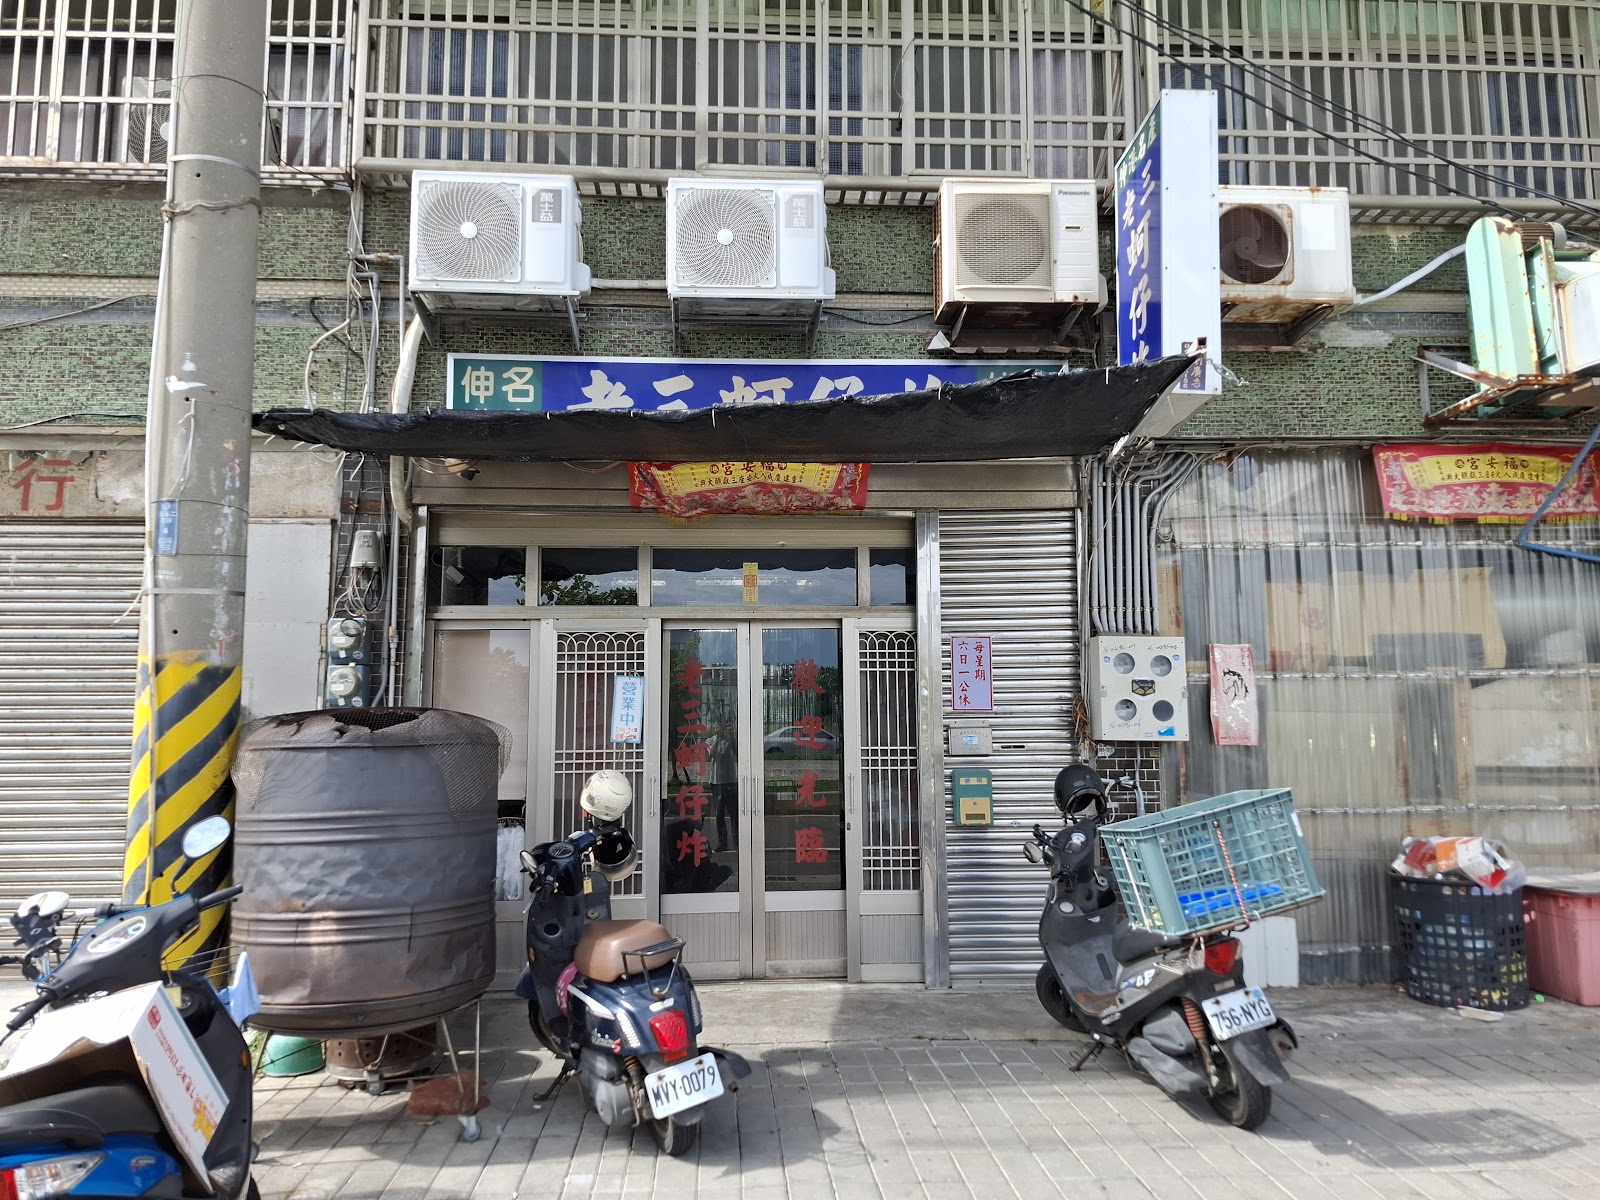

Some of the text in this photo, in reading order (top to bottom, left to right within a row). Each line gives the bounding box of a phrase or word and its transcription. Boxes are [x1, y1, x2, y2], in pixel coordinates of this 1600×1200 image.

[539, 192, 554, 222] 萬士益
[11, 459, 76, 511] 行
[957, 640, 971, 707] 六日一公休
[973, 641, 986, 681] 每星期
[620, 681, 637, 727] 營業中
[673, 657, 710, 868] 老三蚵仔炸
[791, 658, 829, 864] 歡迎光臨
